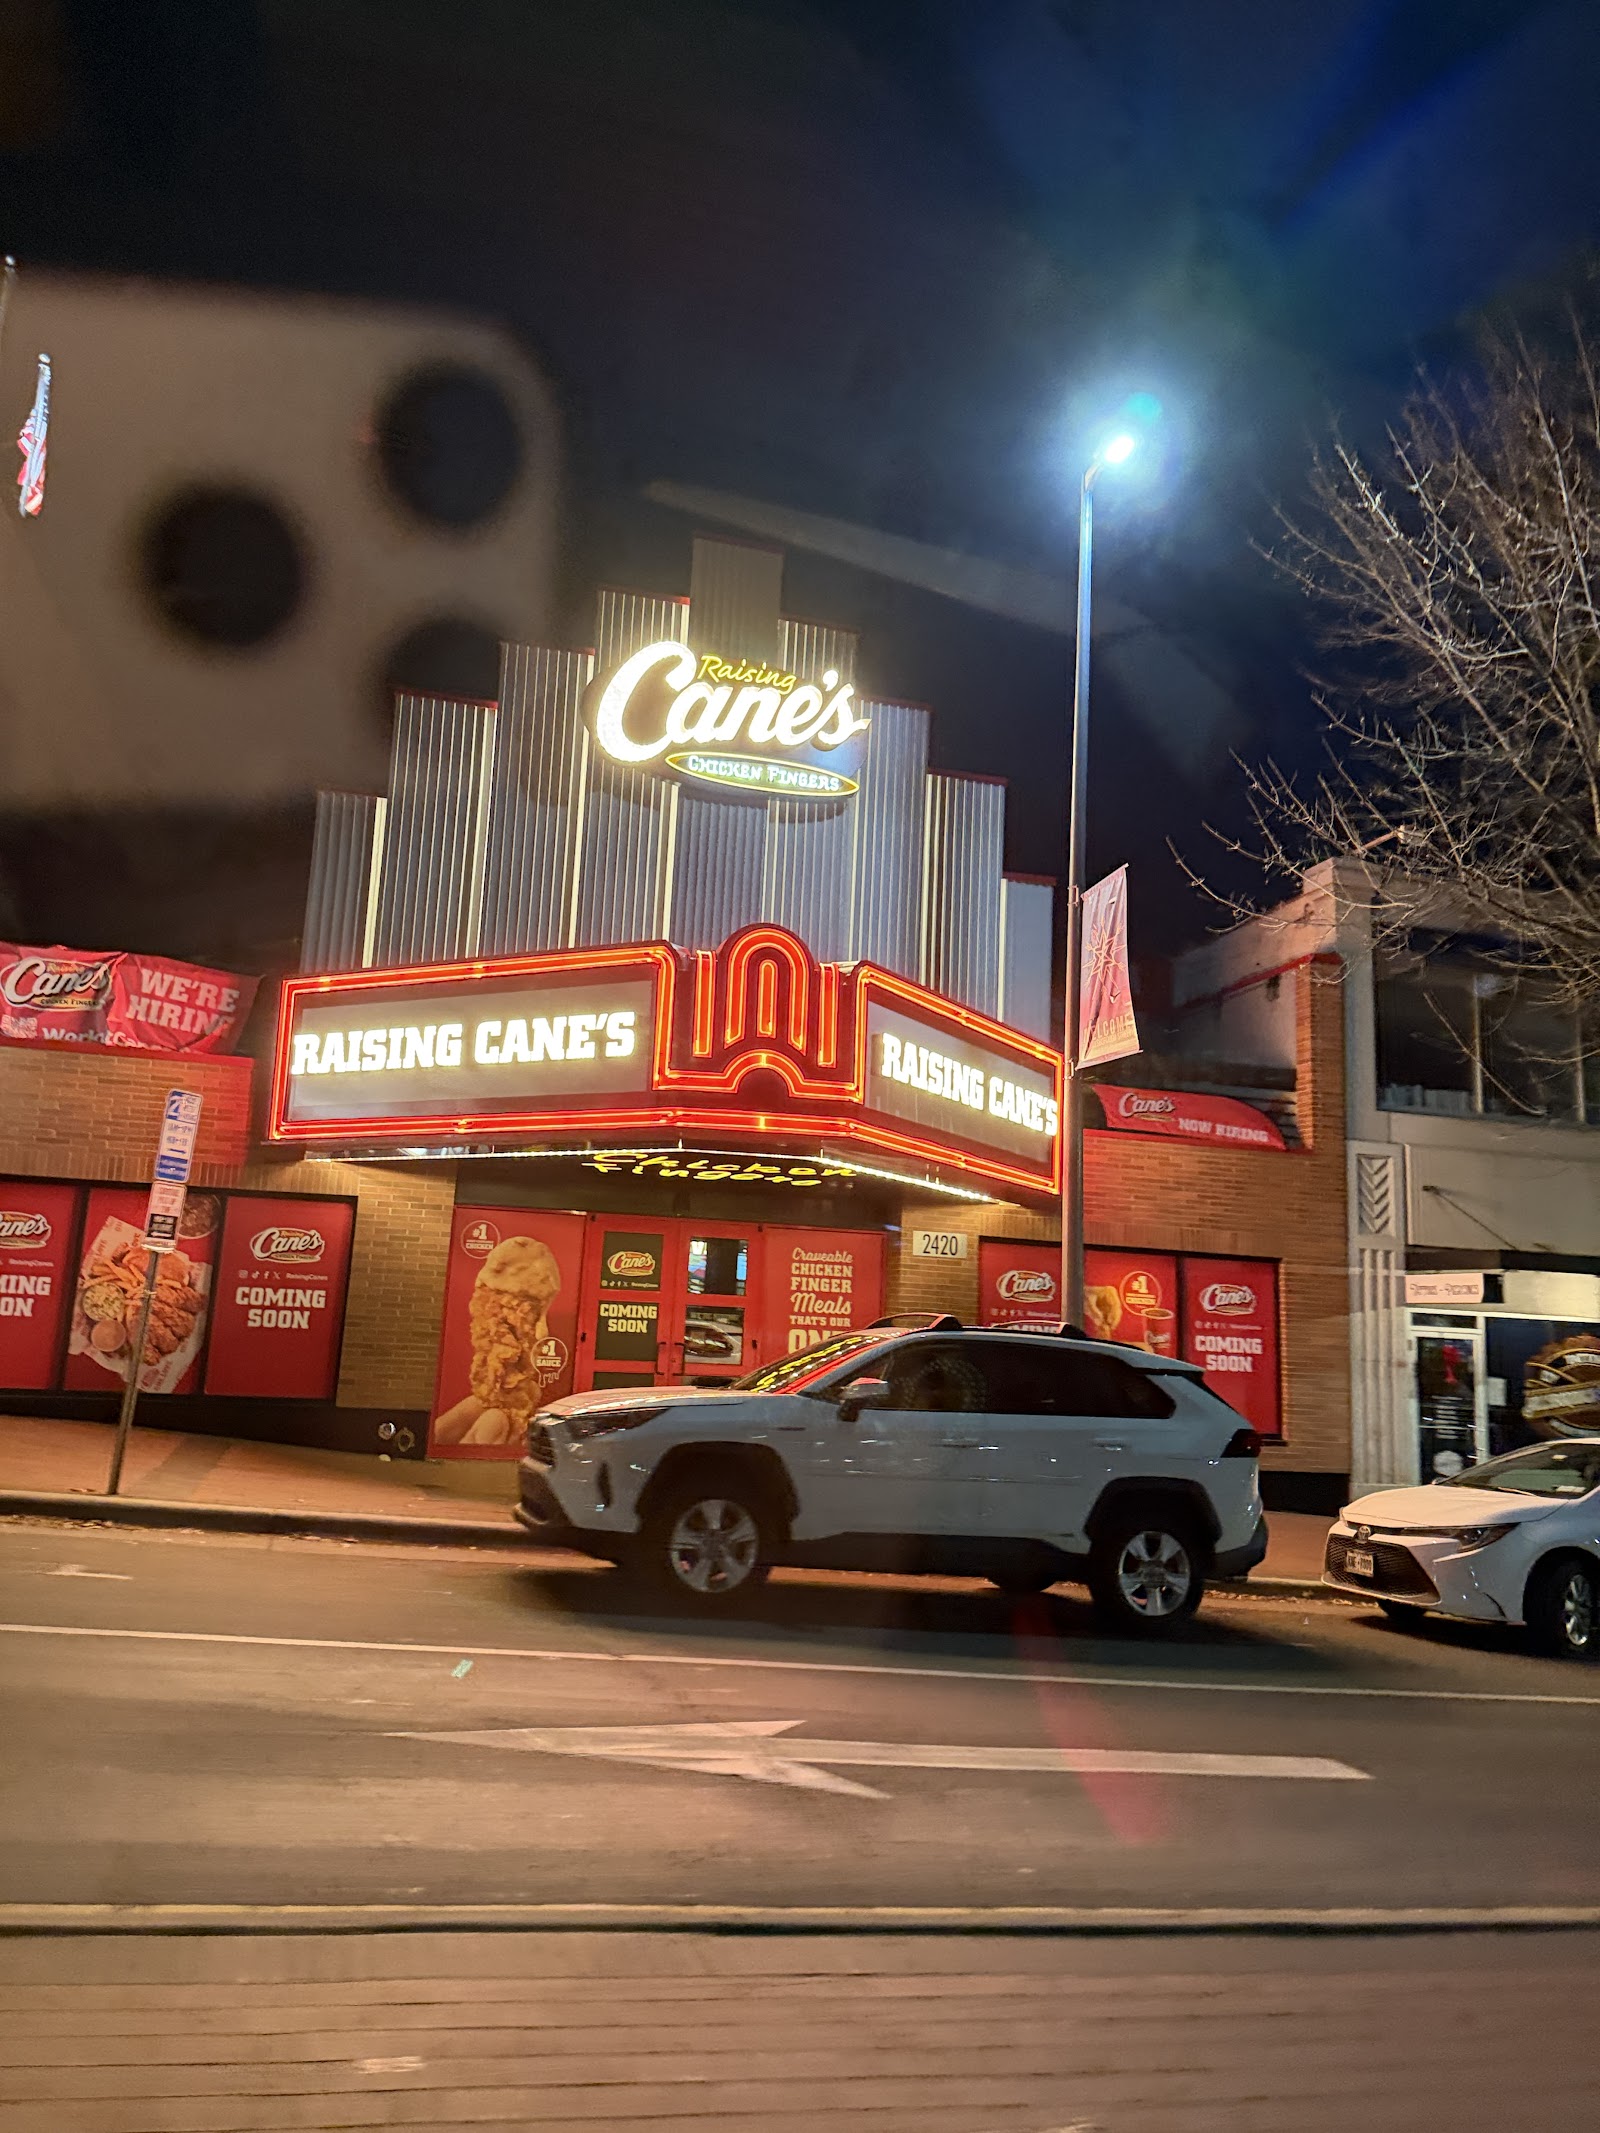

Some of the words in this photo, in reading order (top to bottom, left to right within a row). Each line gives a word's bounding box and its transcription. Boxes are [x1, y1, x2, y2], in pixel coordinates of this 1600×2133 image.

[697, 655, 797, 696] Raising
[596, 641, 872, 763] Cane's
[688, 755, 763, 780] CHICKEN
[767, 766, 840, 791] FINGERS
[141, 968, 240, 1013] WE'RE
[291, 1023, 463, 1075] RAISING
[475, 1011, 635, 1065] CANE'S
[882, 1032, 985, 1111] RAISING
[989, 1076, 1058, 1136] CANE'S
[1119, 1092, 1176, 1118] Cane's
[1179, 1118, 1212, 1133] NOW
[1215, 1124, 1269, 1142] HIRING
[0, 1213, 50, 1237] ane's
[472, 1223, 488, 1240] #1
[254, 1227, 323, 1258] Cane's
[923, 1234, 958, 1256] 2420
[610, 1251, 654, 1273] Cane's
[792, 1247, 853, 1263] Craveable
[791, 1263, 853, 1277] CHICKEN
[0, 1275, 51, 1295] ING
[790, 1277, 853, 1293] FINGER
[1000, 1270, 1054, 1298] Cane's
[1131, 1275, 1148, 1293] #1
[0, 1297, 34, 1317] ON
[235, 1287, 326, 1309] COMING
[790, 1292, 852, 1315] Meals
[247, 1309, 310, 1329] SOON
[600, 1304, 658, 1319] COMING
[789, 1315, 827, 1326] THAT'S
[829, 1318, 851, 1328] OUR
[607, 1319, 648, 1333] SOON
[541, 1340, 556, 1356] #1
[1195, 1335, 1263, 1354] COMING
[1206, 1355, 1253, 1372] SOON
